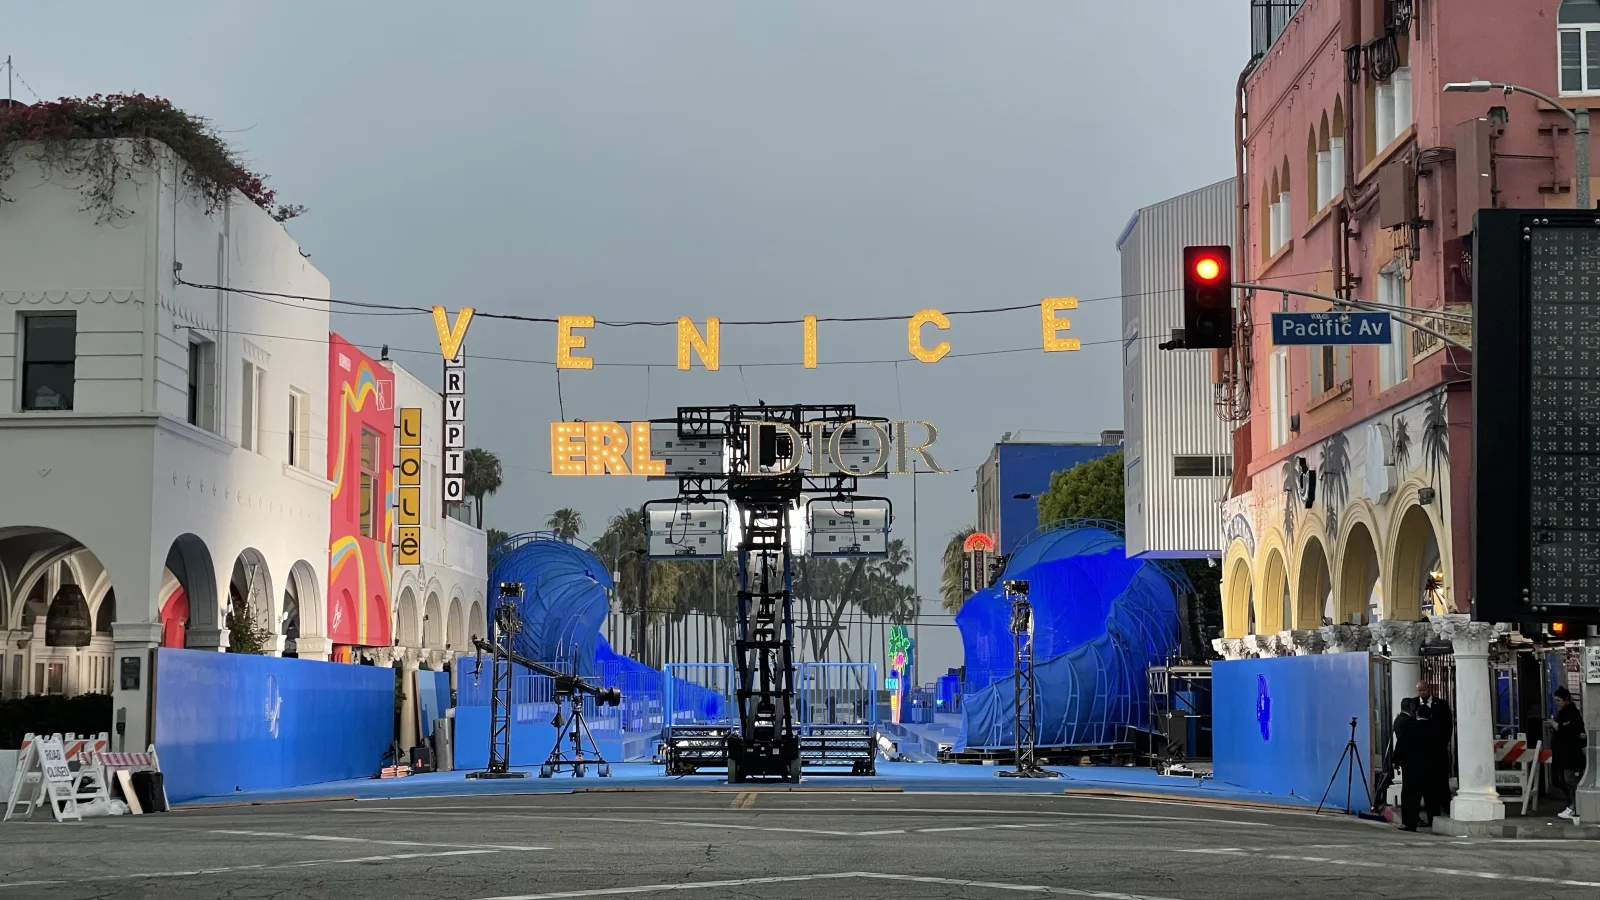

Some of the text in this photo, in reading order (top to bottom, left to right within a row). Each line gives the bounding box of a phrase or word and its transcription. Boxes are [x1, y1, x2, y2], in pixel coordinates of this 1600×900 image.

[432, 296, 1081, 370] VENICE
[1282, 319, 1383, 336] Pacific Av
[550, 419, 951, 476] ERL DIOR
[45, 749, 61, 760] ROAD
[47, 767, 69, 778] CLOSED
